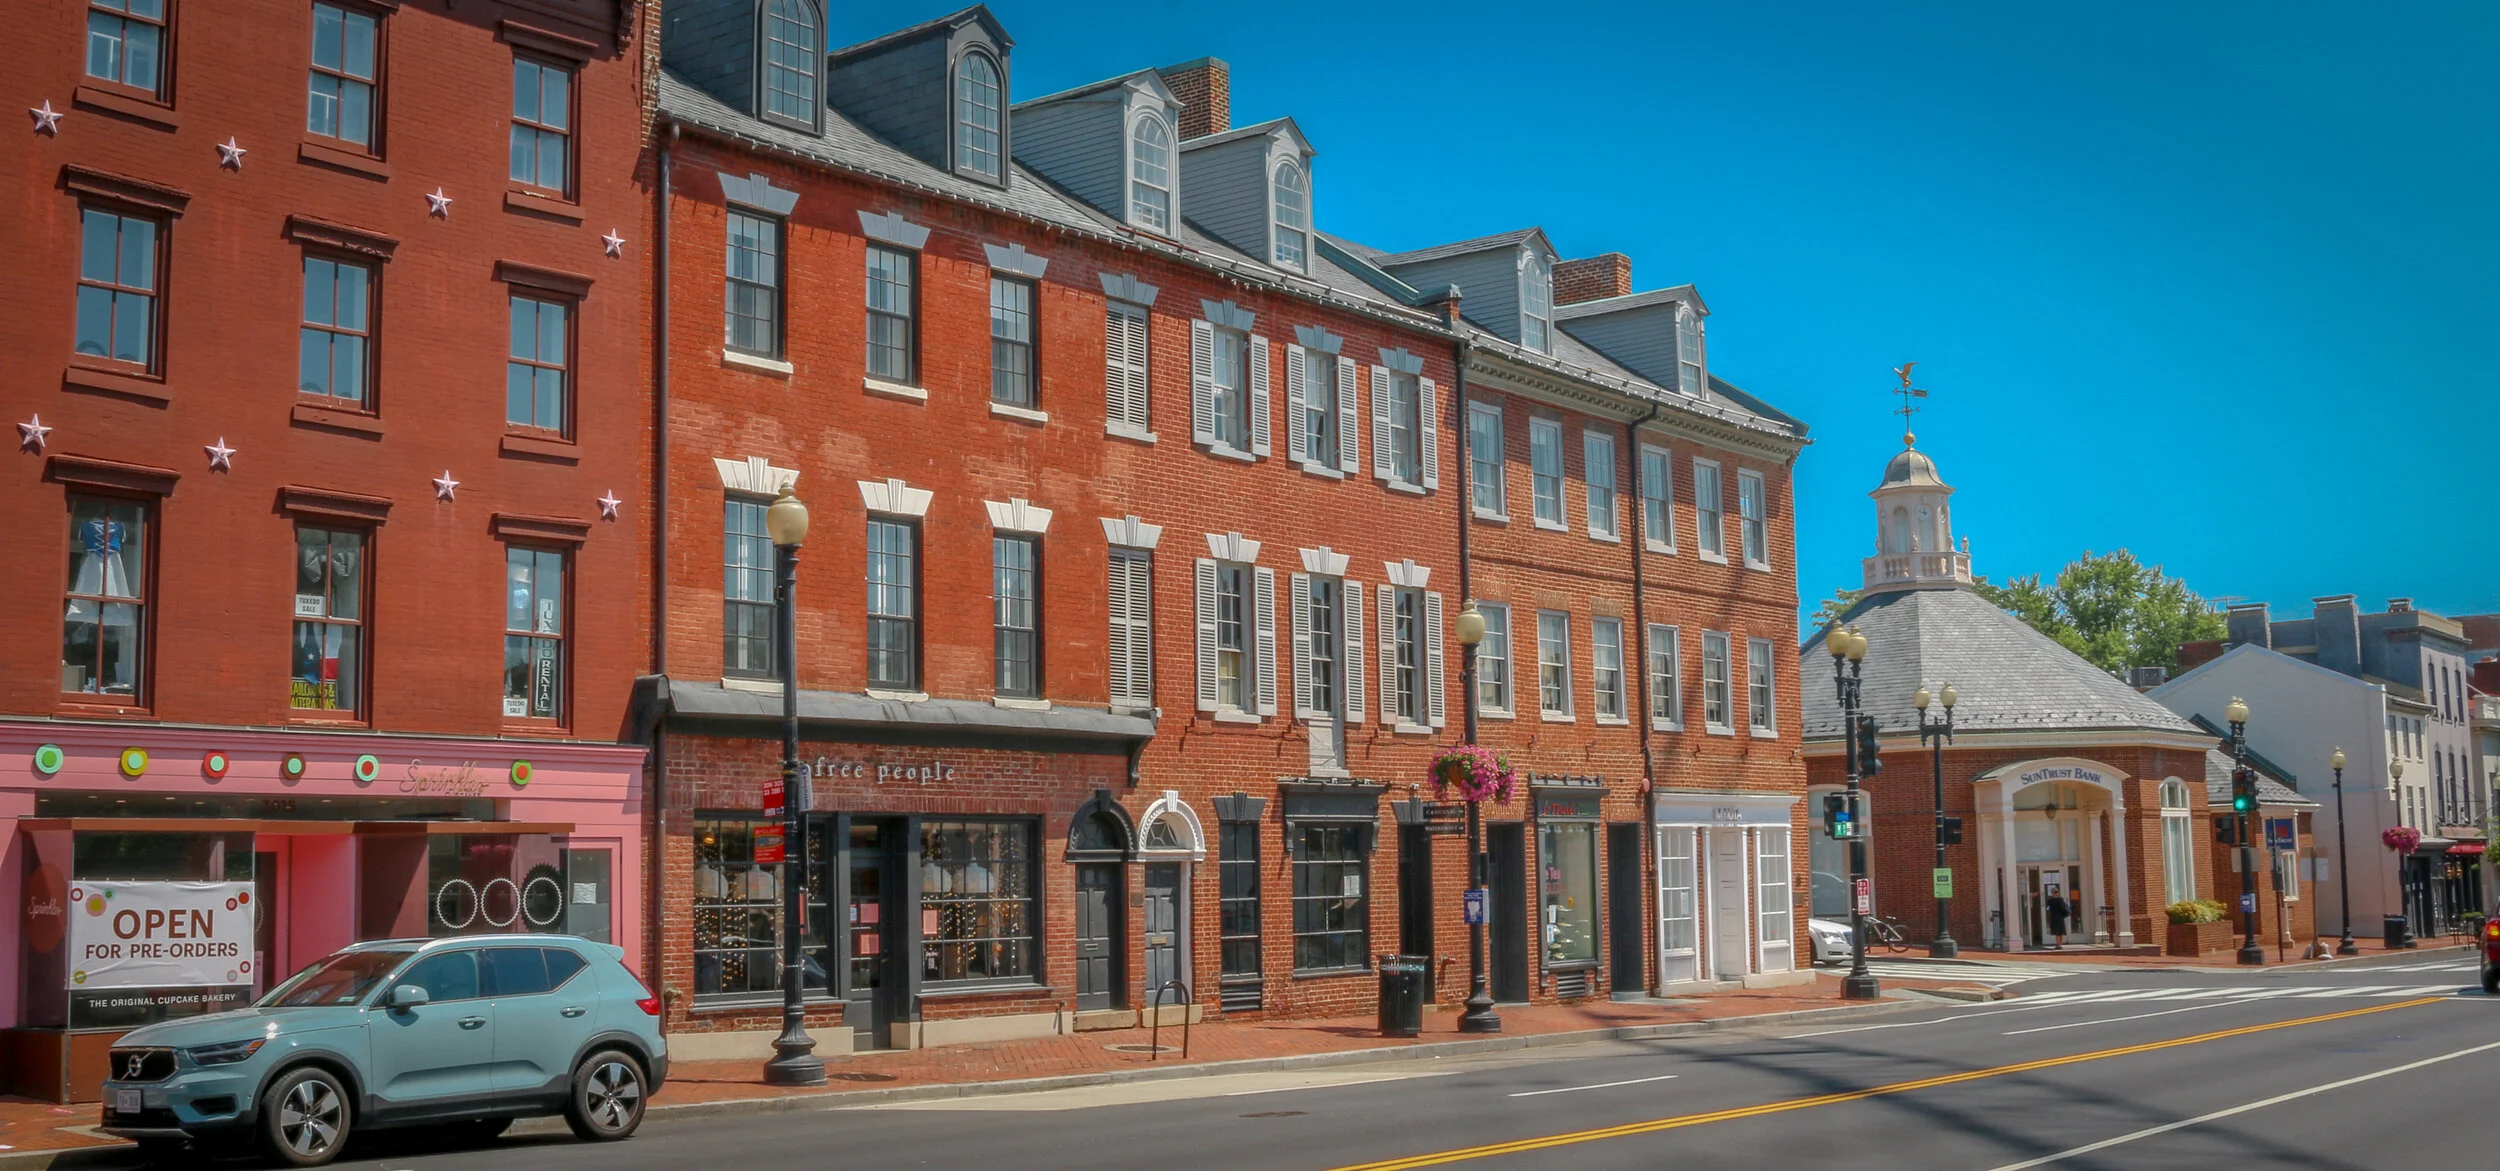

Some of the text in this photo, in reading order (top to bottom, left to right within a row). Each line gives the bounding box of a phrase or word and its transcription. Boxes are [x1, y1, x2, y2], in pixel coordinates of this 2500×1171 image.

[299, 597, 320, 605] TUXEDO
[540, 660, 551, 709] RENTAL
[399, 759, 489, 794] Sprinkles
[814, 757, 955, 785] free people
[113, 909, 213, 939] OPEN
[85, 942, 238, 959] FOR PRE-ORDERS
[89, 993, 236, 1008] THE ORIGINAL CUPCAKE BAKERY
